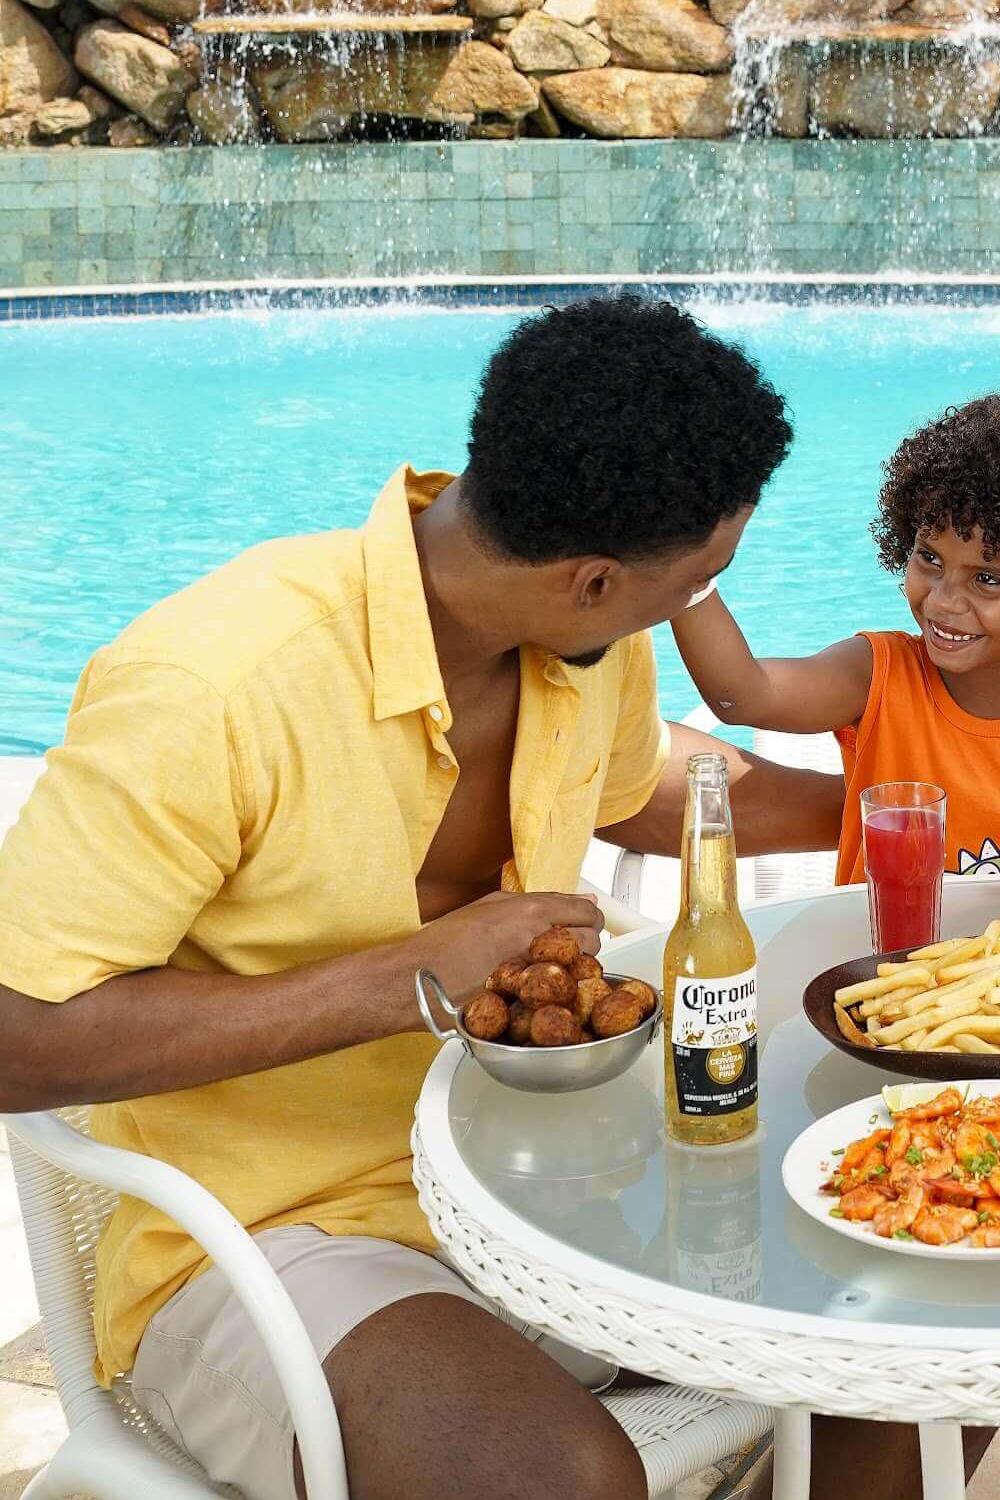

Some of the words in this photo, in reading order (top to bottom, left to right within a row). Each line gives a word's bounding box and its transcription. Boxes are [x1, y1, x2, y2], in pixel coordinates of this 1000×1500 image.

[682, 979, 755, 1014] Corona
[706, 1008, 747, 1025] Extra
[710, 1053, 743, 1066] CERVEZA
[721, 1050, 732, 1058] LA
[719, 1062, 736, 1071] MAS
[718, 1069, 736, 1078] FINA
